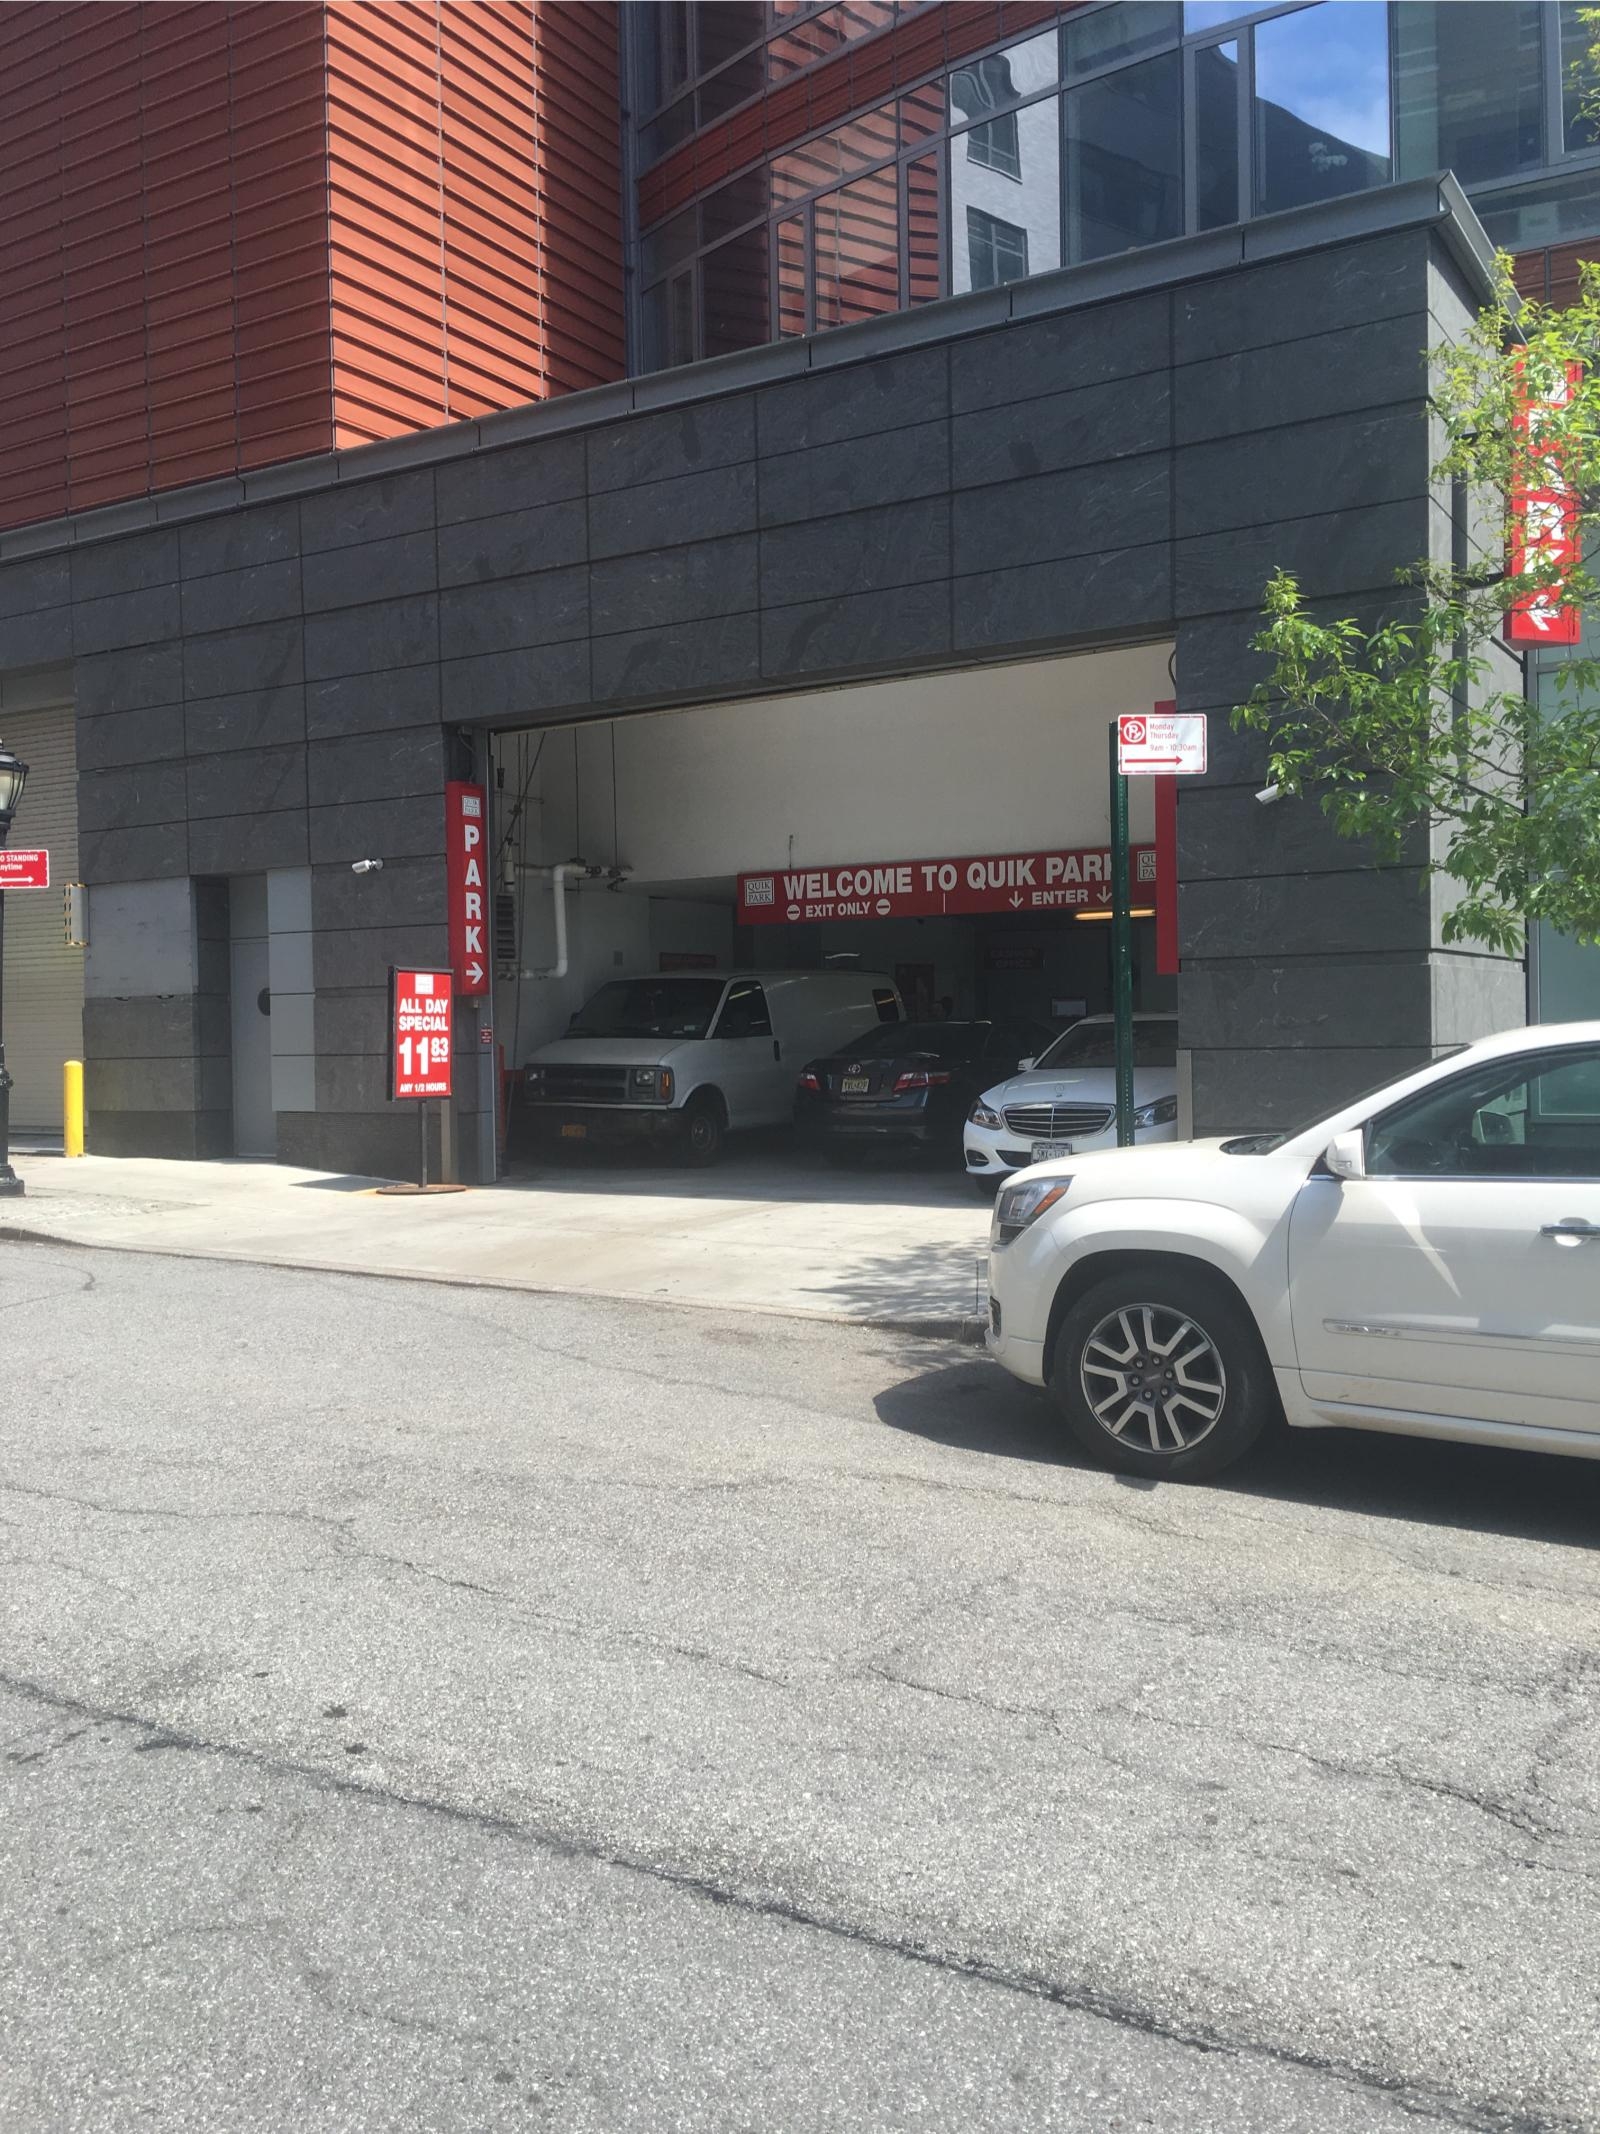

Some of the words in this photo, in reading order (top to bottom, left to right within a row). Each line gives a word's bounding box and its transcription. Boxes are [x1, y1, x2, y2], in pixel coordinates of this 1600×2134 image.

[1149, 723, 1175, 731] Monday
[1149, 731, 1179, 740] Thursday
[6, 854, 39, 862] STANDING
[1142, 854, 1156, 865] QU
[0, 863, 23, 872] nytime
[1142, 868, 1156, 877] PA
[783, 867, 913, 900] WELCOME
[921, 864, 958, 891] TO
[966, 858, 1037, 890] QUIK
[465, 824, 482, 953] PARK
[748, 882, 771, 892] QUIK
[748, 893, 772, 904] PARK
[1031, 889, 1089, 906] ENTER
[805, 904, 835, 918] EXIT
[837, 902, 871, 917] ONLY
[399, 998, 422, 1013] ALL
[425, 998, 449, 1013] DAY
[399, 1016, 448, 1031] SPECIAL
[431, 1037, 449, 1057] 83
[400, 1082, 412, 1093] ANY
[426, 1082, 447, 1092] HOURS
